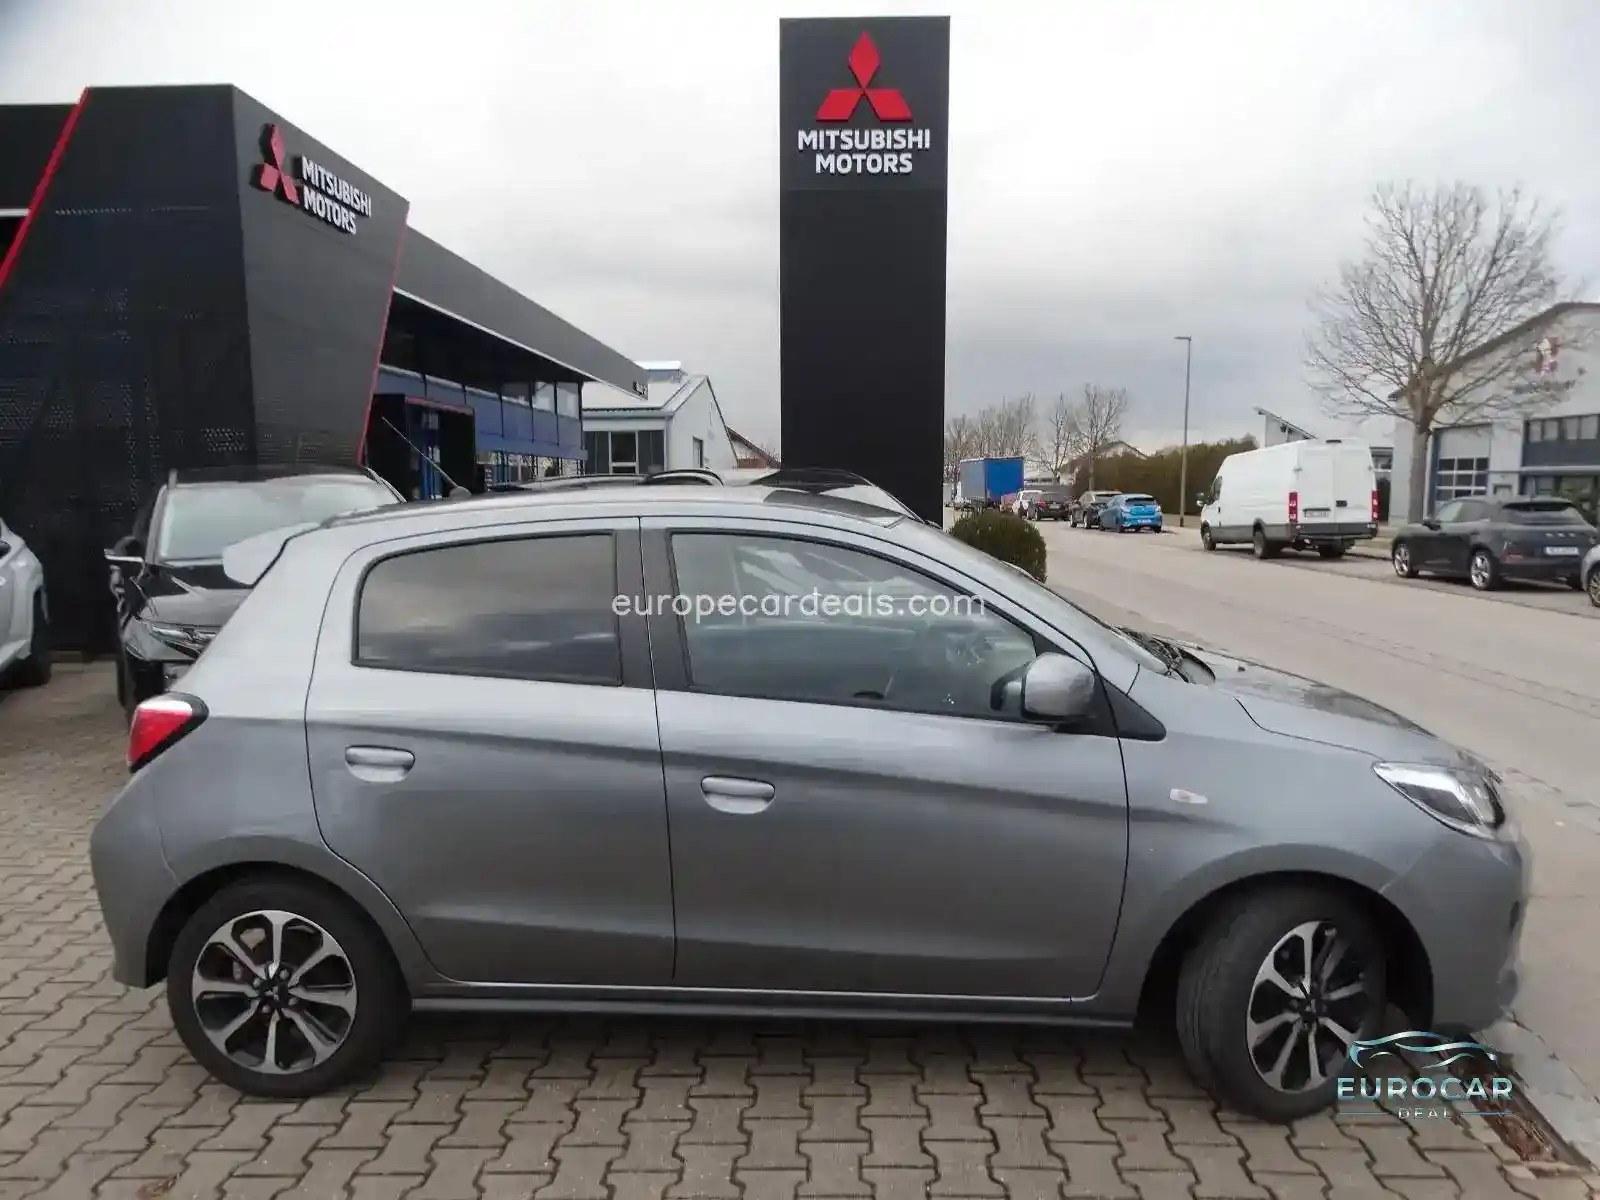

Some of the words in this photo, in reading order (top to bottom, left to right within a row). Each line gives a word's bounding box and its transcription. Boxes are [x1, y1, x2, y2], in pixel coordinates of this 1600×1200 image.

[798, 129, 931, 151] MITSUBISHI
[815, 153, 913, 174] MOTORS
[302, 153, 371, 218] MITSUBISHI
[303, 185, 357, 234] MOTORS
